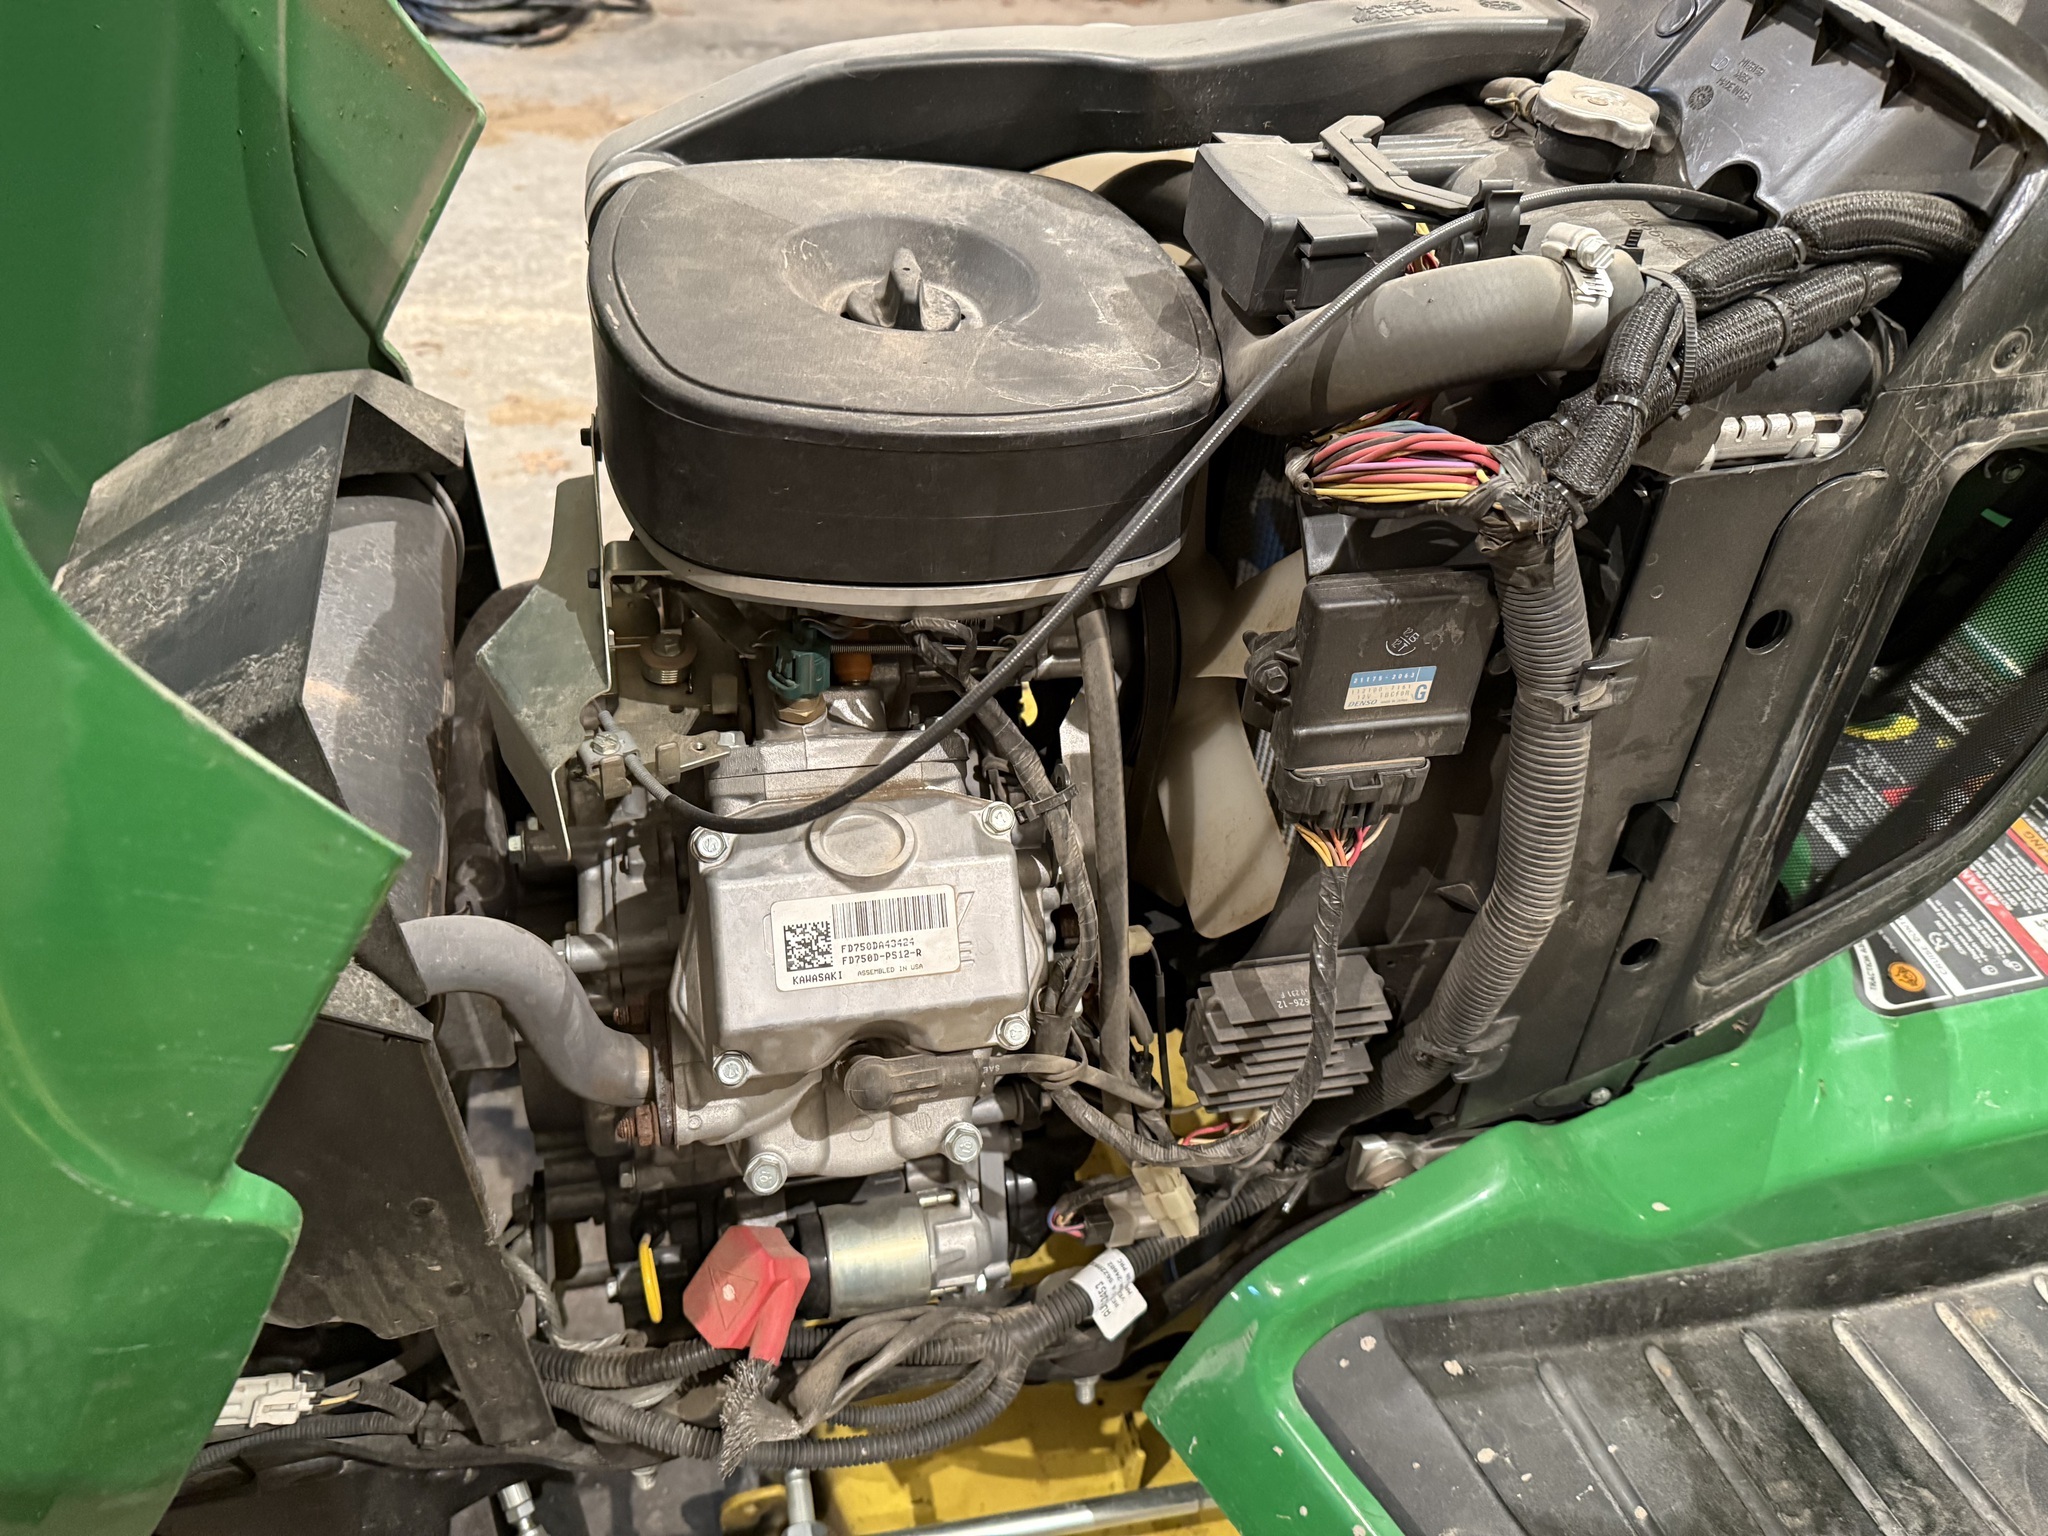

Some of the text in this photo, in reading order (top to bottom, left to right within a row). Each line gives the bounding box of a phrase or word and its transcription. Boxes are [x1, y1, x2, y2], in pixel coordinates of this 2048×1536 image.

[1414, 684, 1427, 700] G
[1348, 699, 1378, 707] DENSO
[1921, 946, 1948, 974] CRUISE
[792, 970, 843, 985] KAWASAKI
[857, 966, 895, 977] ASSEMBLED
[983, 1064, 1000, 1074] SAE
